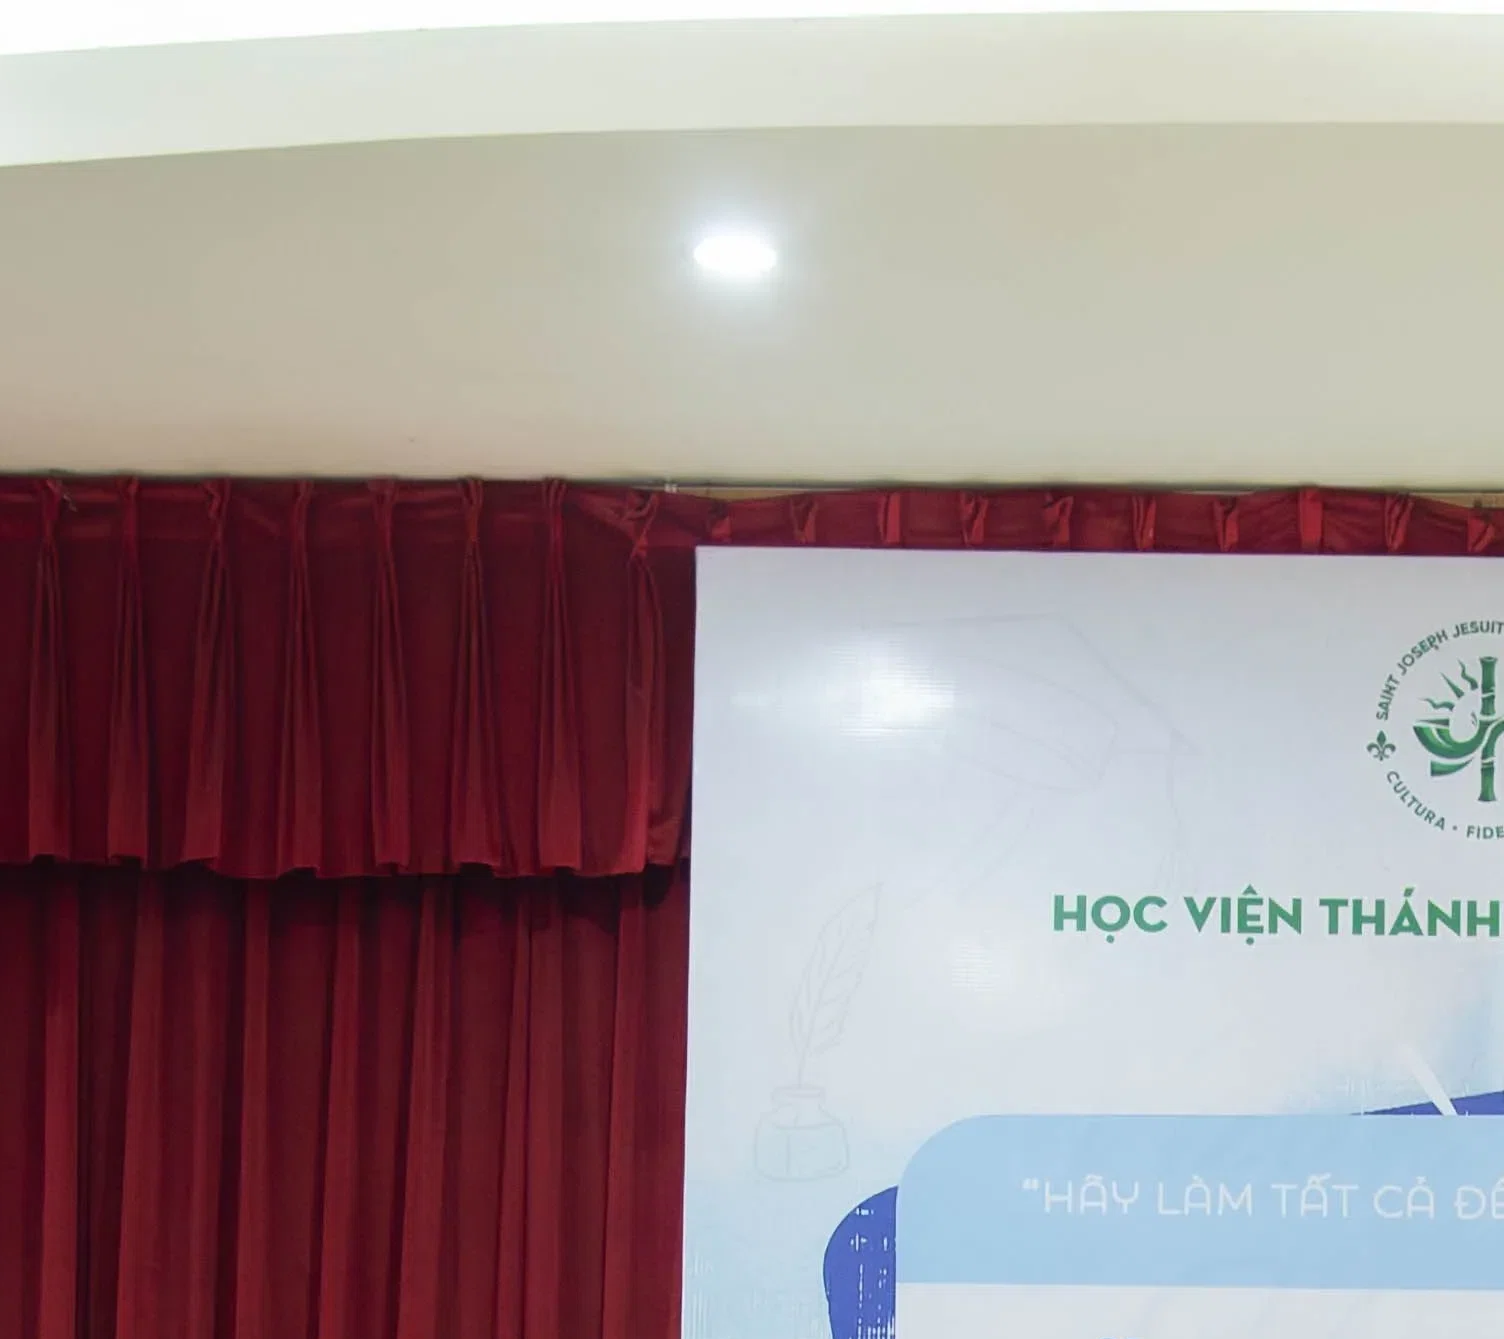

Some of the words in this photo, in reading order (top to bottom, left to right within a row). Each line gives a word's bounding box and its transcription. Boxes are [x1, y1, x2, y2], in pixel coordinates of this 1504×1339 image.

[1376, 674, 1400, 722] SAINT
[1399, 630, 1449, 676] JOSEPH
[1453, 620, 1504, 639] JESUIT
[1386, 770, 1446, 831] CULTURA
[1053, 894, 1168, 944] HỌC
[1183, 883, 1302, 946] VIỆN
[1318, 887, 1500, 937] THÁNH
[1157, 1174, 1253, 1217] LÀM
[1271, 1171, 1359, 1219] TẤT
[1373, 1175, 1435, 1219] CẢ
